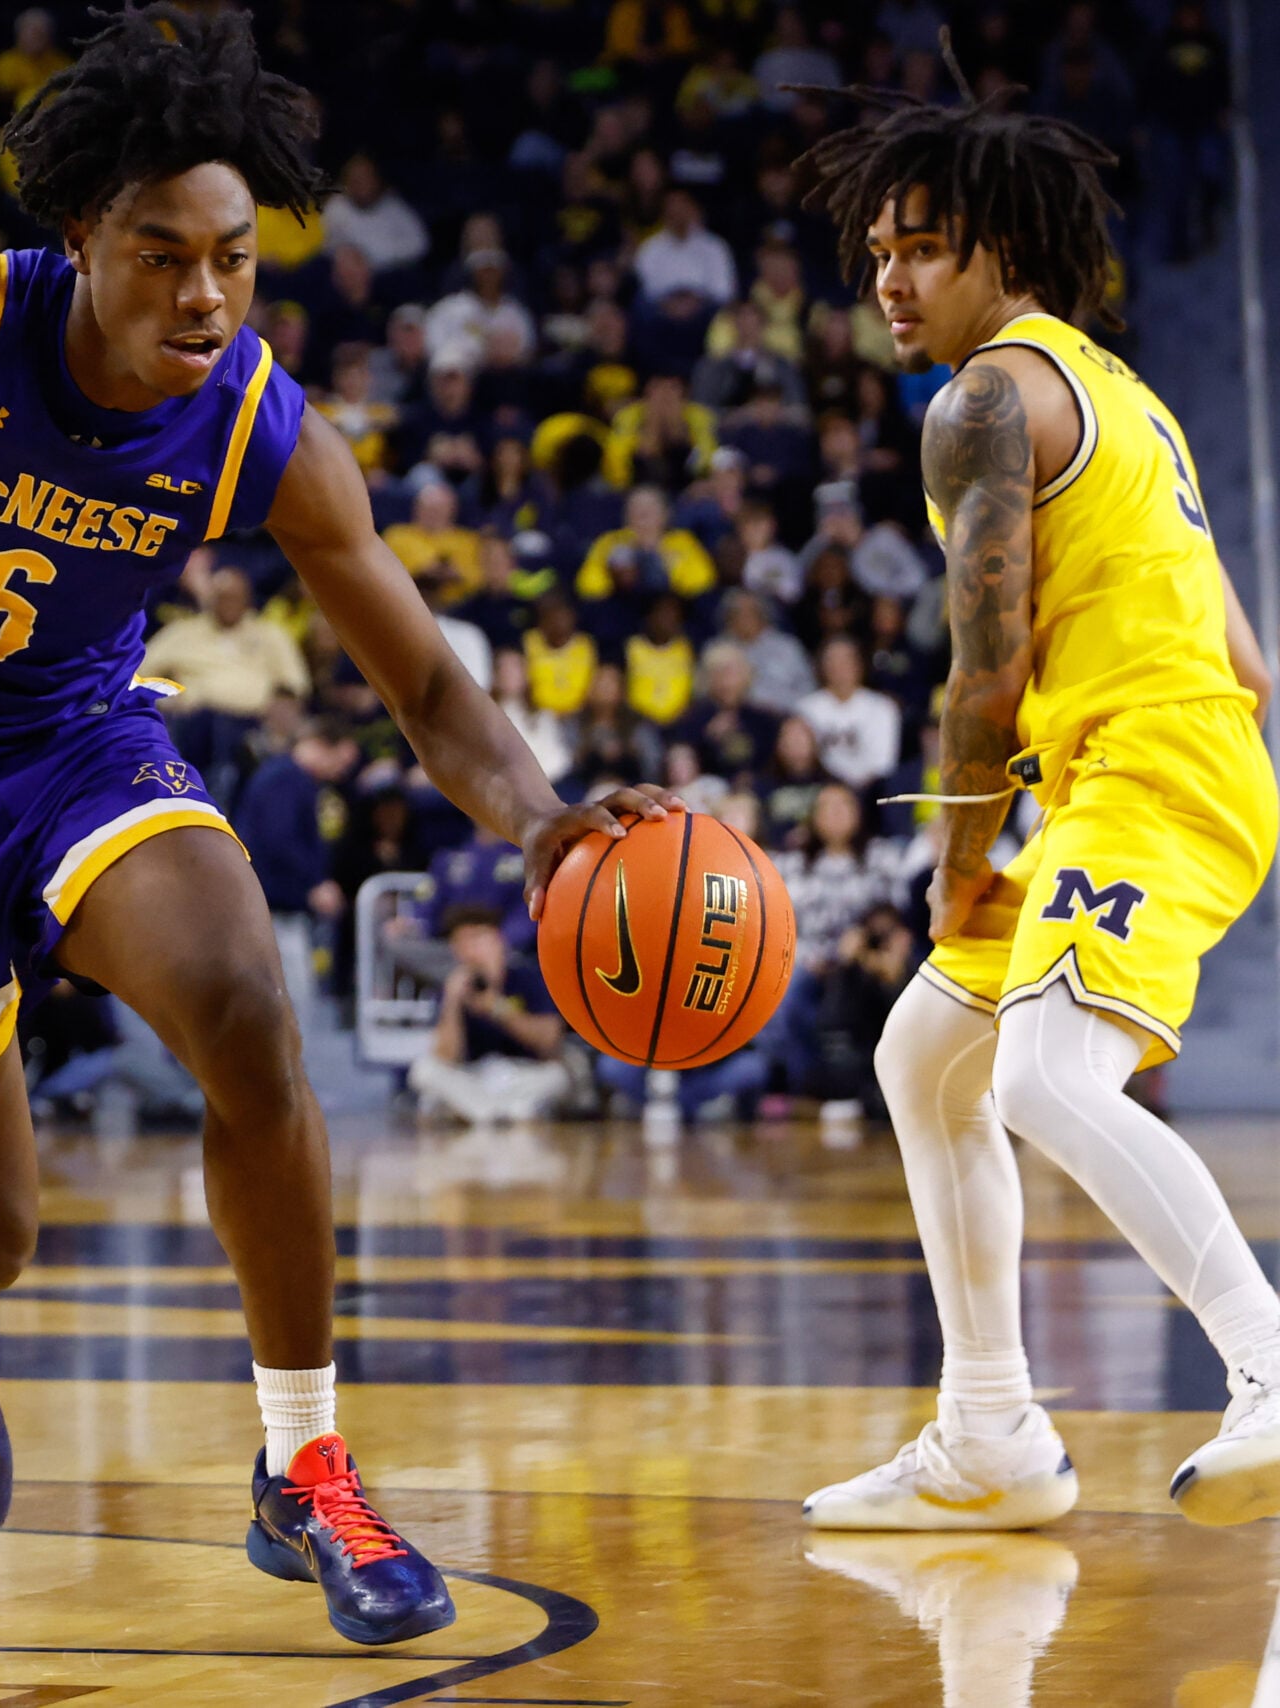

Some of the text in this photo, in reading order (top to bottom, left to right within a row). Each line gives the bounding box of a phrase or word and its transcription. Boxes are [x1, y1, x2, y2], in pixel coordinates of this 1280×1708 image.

[145, 473, 203, 495] SLC
[682, 872, 738, 1012] ELITE
[1040, 867, 1147, 943] M
